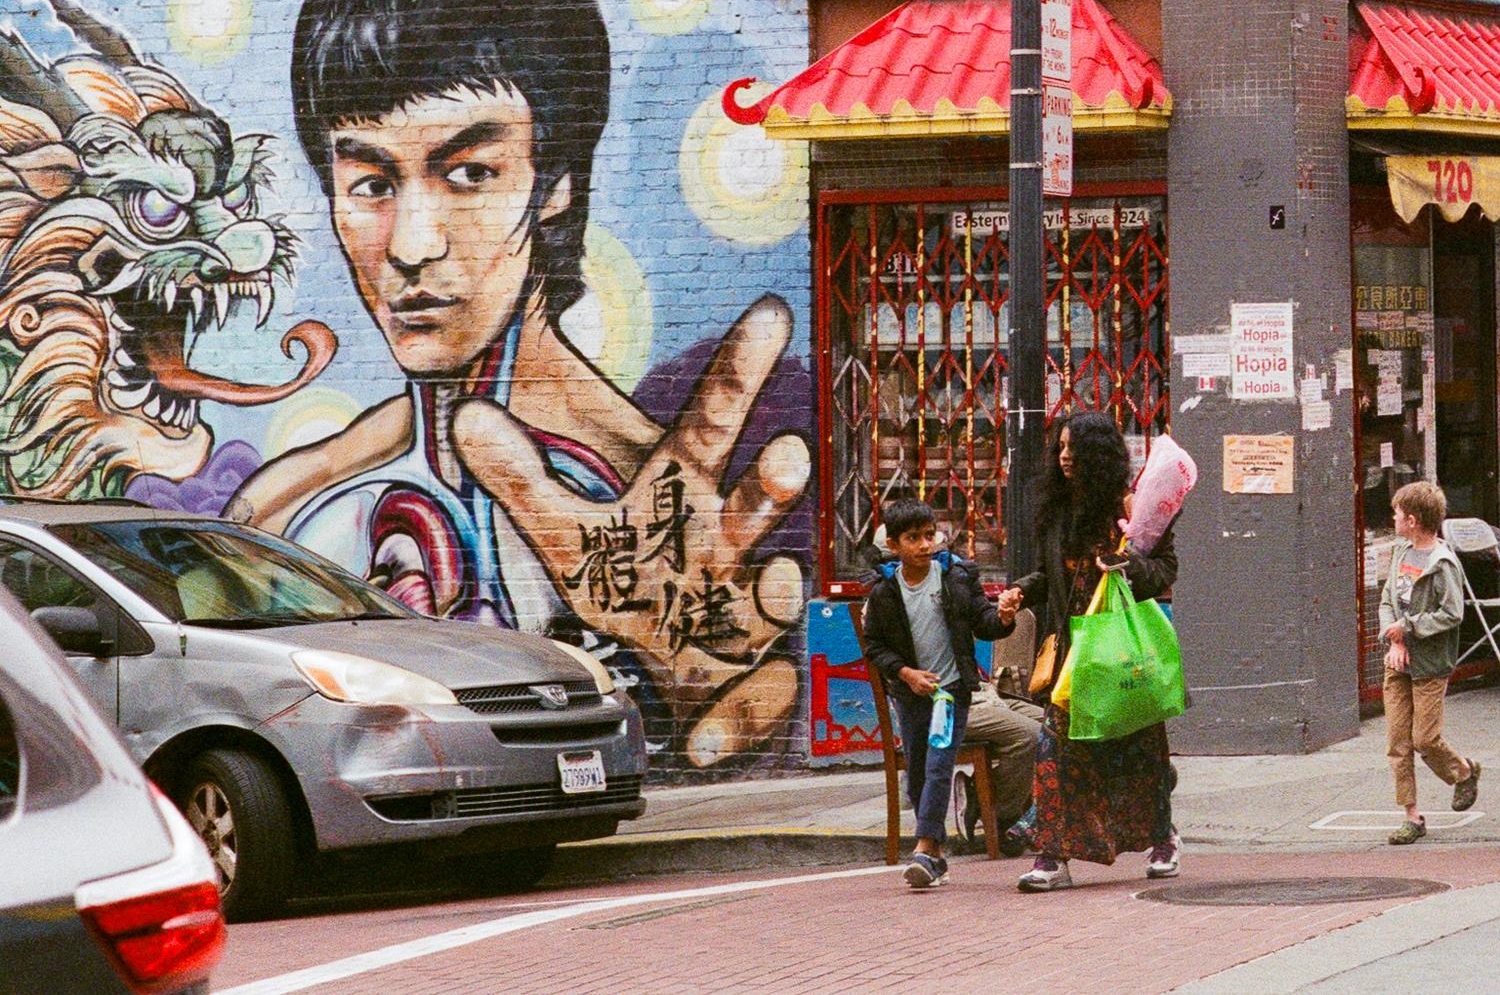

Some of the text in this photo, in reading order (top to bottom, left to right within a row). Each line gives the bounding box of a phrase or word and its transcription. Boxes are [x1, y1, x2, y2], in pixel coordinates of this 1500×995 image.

[1427, 160, 1474, 204] 720
[1243, 328, 1280, 344] Hopia
[1235, 353, 1288, 376] Hopia
[1244, 380, 1281, 394] Hopia
